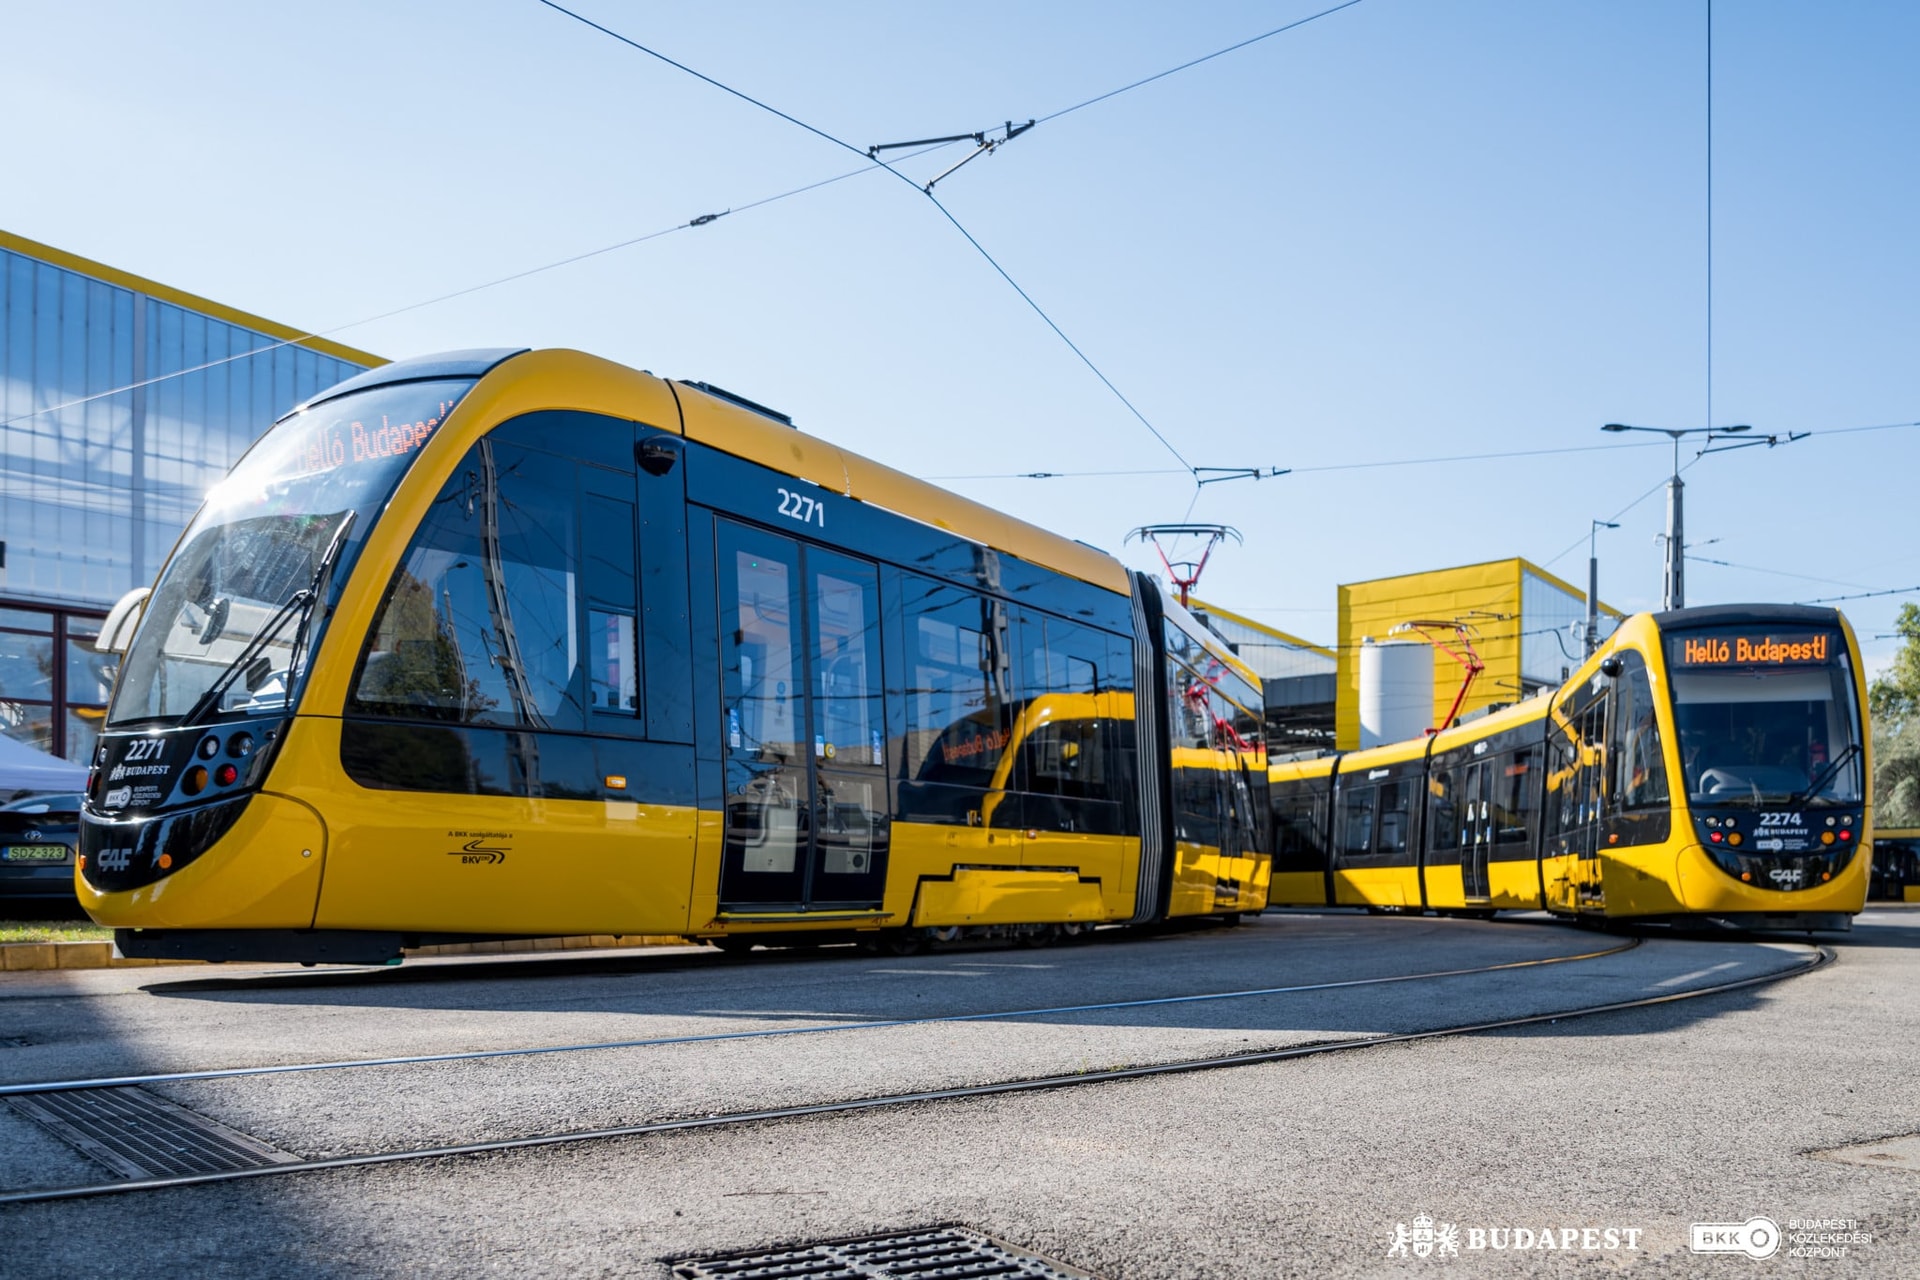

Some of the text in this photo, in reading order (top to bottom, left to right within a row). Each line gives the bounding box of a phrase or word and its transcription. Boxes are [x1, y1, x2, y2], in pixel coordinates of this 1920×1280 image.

[777, 488, 824, 528] 2271
[1685, 635, 1827, 663] Helló Budapest!
[125, 738, 166, 761] 2271
[125, 765, 171, 776] BUDAPEST
[1759, 812, 1803, 826] 2274
[11, 847, 63, 858] SDZ-323
[98, 848, 132, 872] CAF
[1769, 869, 1802, 883] CAF
